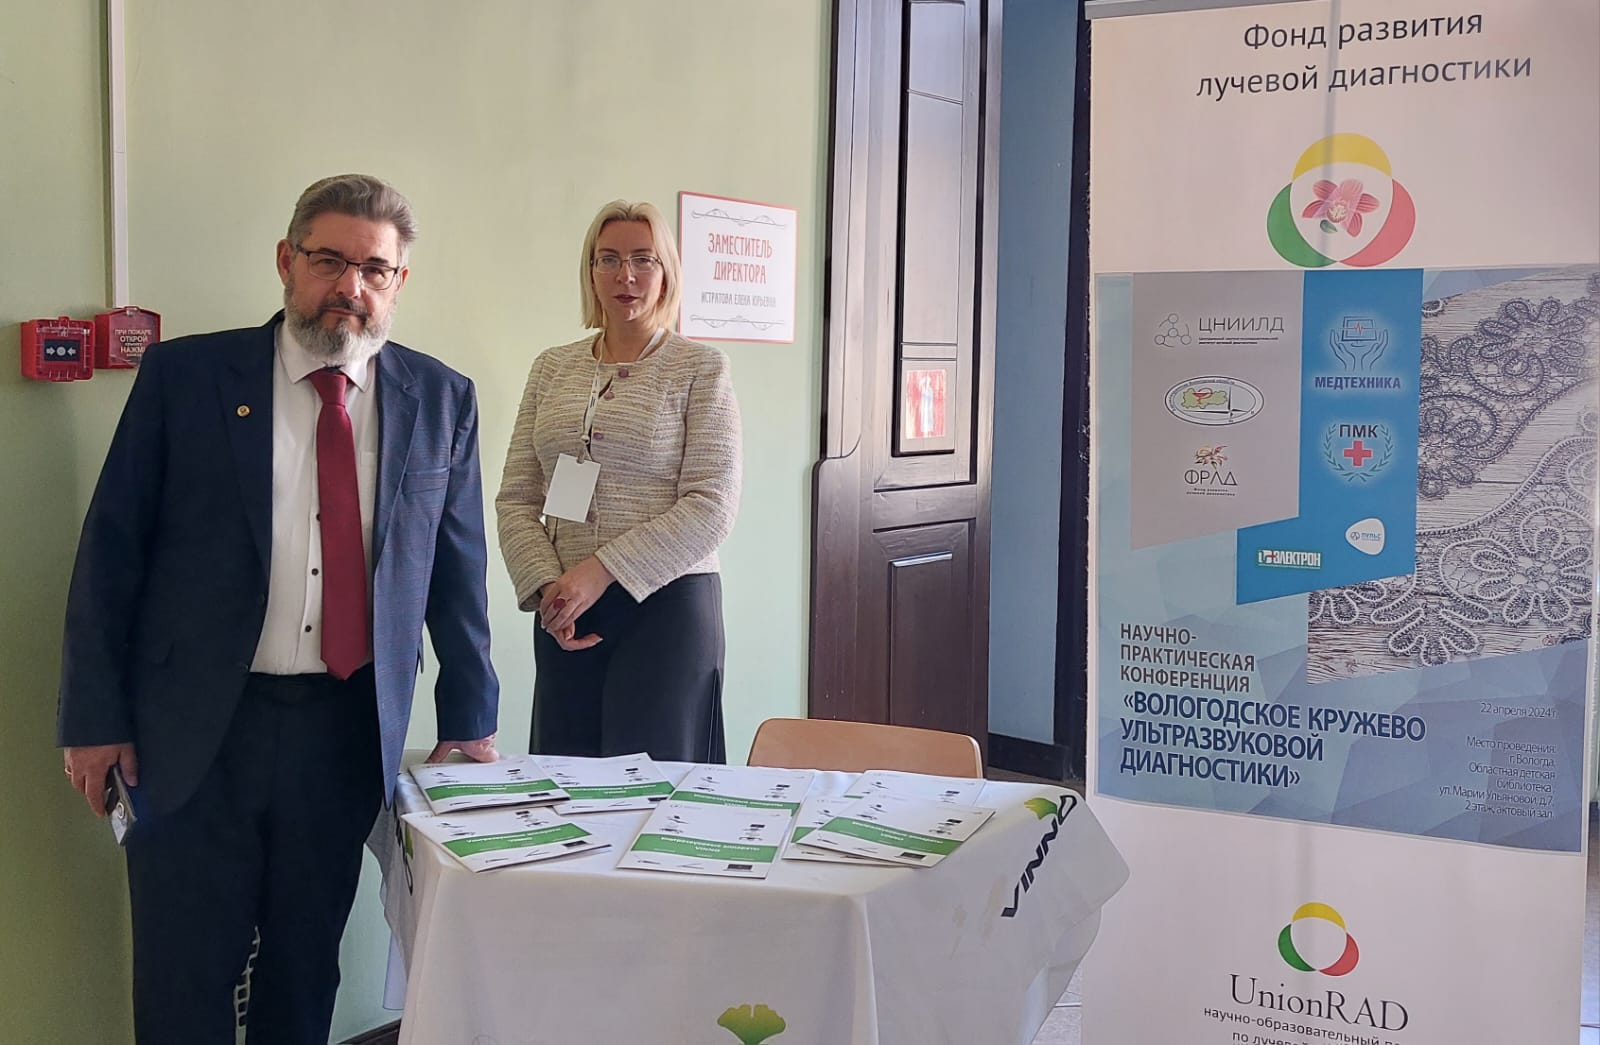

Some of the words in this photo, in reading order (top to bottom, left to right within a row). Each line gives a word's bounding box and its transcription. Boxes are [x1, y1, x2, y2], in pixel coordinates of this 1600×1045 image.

[1244, 24, 1327, 49] Фонд
[1339, 14, 1483, 49] развития
[1196, 65, 1318, 101] лучевой
[1328, 57, 1532, 92] диагностики
[708, 233, 773, 259] ЗАМЕСТИТЕЛЬ
[713, 261, 767, 284] ДИРЕКТОРА
[1199, 317, 1284, 334] ЦНИИЛД
[120, 335, 149, 343] ОТКРОЙ
[1314, 376, 1401, 390] МЕДТЕХНИКА
[1339, 424, 1378, 438] ПМК
[1273, 550, 1321, 567] ЭЛЕКТРОН
[1121, 623, 1197, 645] НАУЧНО-
[1120, 644, 1255, 672] ПРАКТИЧЕСКАЯ
[1120, 665, 1250, 694] КОНФЕРЕНЦИЯ
[1123, 691, 1300, 729] «ВОЛОГОДСКОЕ
[1308, 707, 1426, 742] КРУЖЕВО
[1481, 702, 1492, 713] 22
[1493, 706, 1527, 717] апреля
[1528, 707, 1551, 718] 2024
[1121, 718, 1323, 761] УЛЬТРАЗВУКОВОЙ
[1467, 735, 1496, 749] Место
[1120, 747, 1300, 788] ДИАГНОСТИКИ»
[1469, 762, 1518, 776] Областная
[1519, 770, 1556, 781] детская
[1452, 785, 1485, 799] Марии
[1496, 807, 1536, 817] актовый
[1001, 795, 1077, 918] VINNO
[1229, 974, 1409, 1031] UnionRAD
[1203, 1006, 1379, 1045] научно-образовательный
[1233, 1032, 1249, 1043] по
